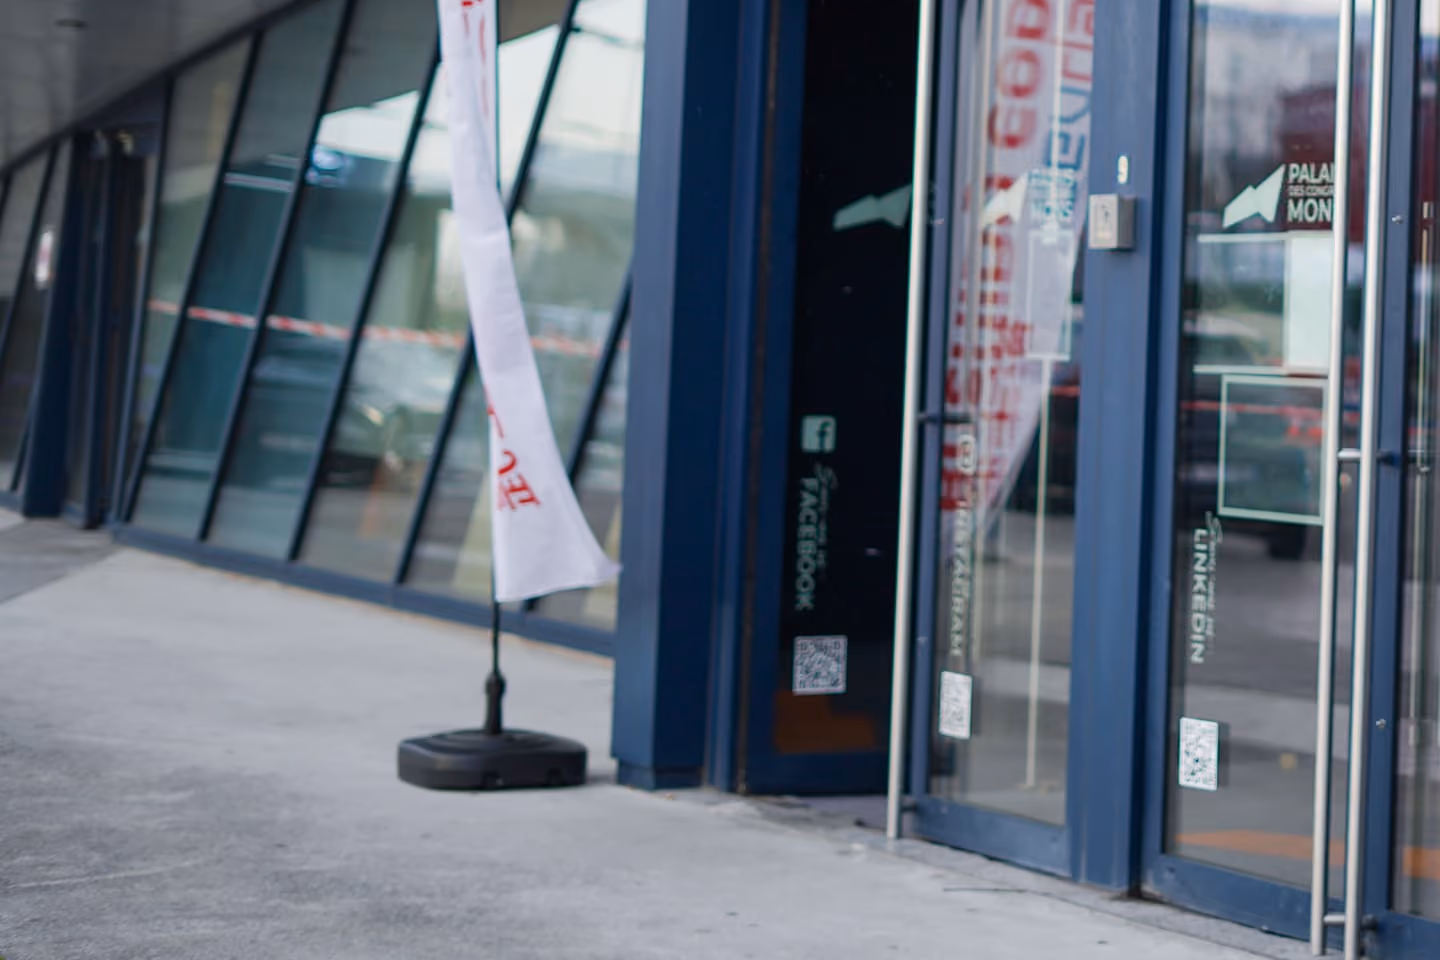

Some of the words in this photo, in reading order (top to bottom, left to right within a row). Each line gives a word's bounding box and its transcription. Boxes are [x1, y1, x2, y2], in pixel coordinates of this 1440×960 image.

[1287, 198, 1332, 224] MON
[1288, 162, 1335, 184] PALAI
[794, 477, 819, 611] FACEBOOK
[1189, 528, 1209, 664] LINKEDIN
